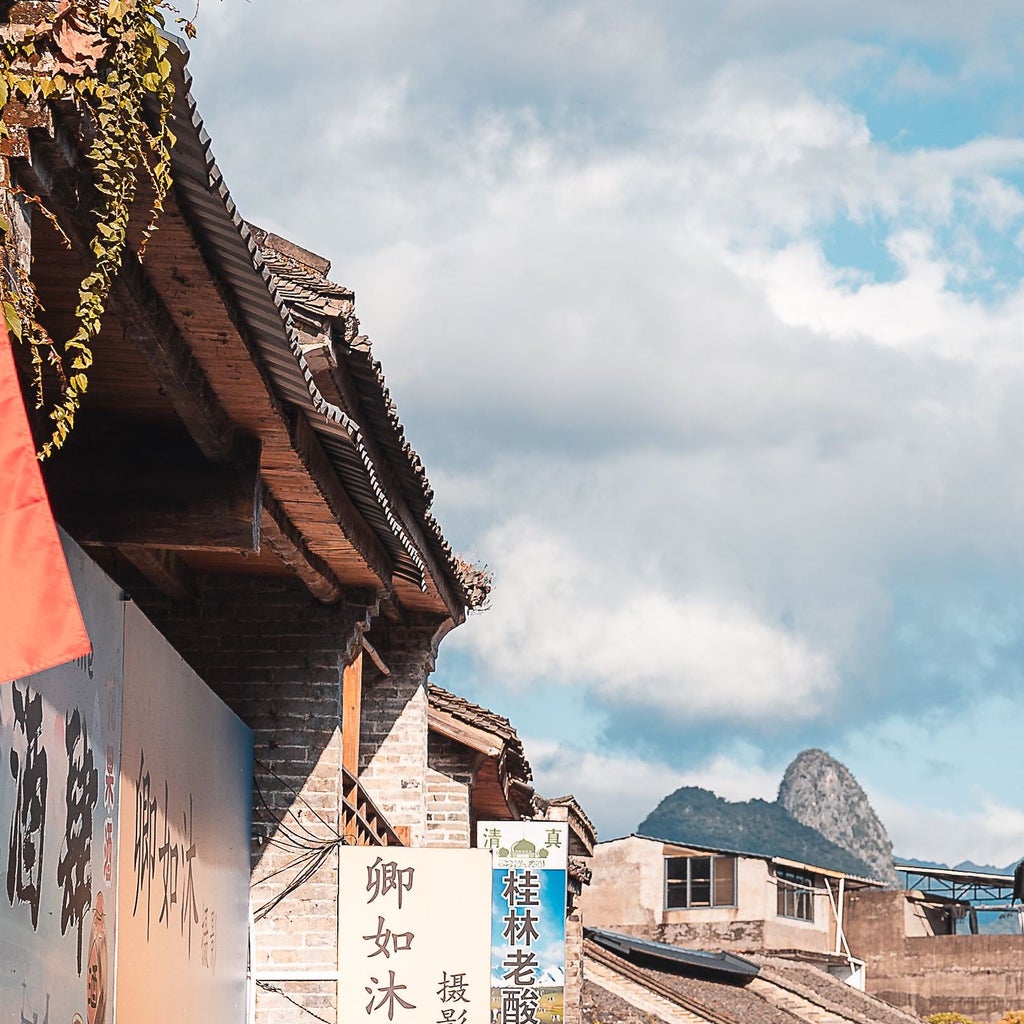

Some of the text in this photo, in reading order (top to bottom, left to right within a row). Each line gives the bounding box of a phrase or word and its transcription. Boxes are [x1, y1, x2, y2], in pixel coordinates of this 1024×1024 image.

[483, 827, 563, 849] 清真
[362, 855, 417, 1022] 卿如沐
